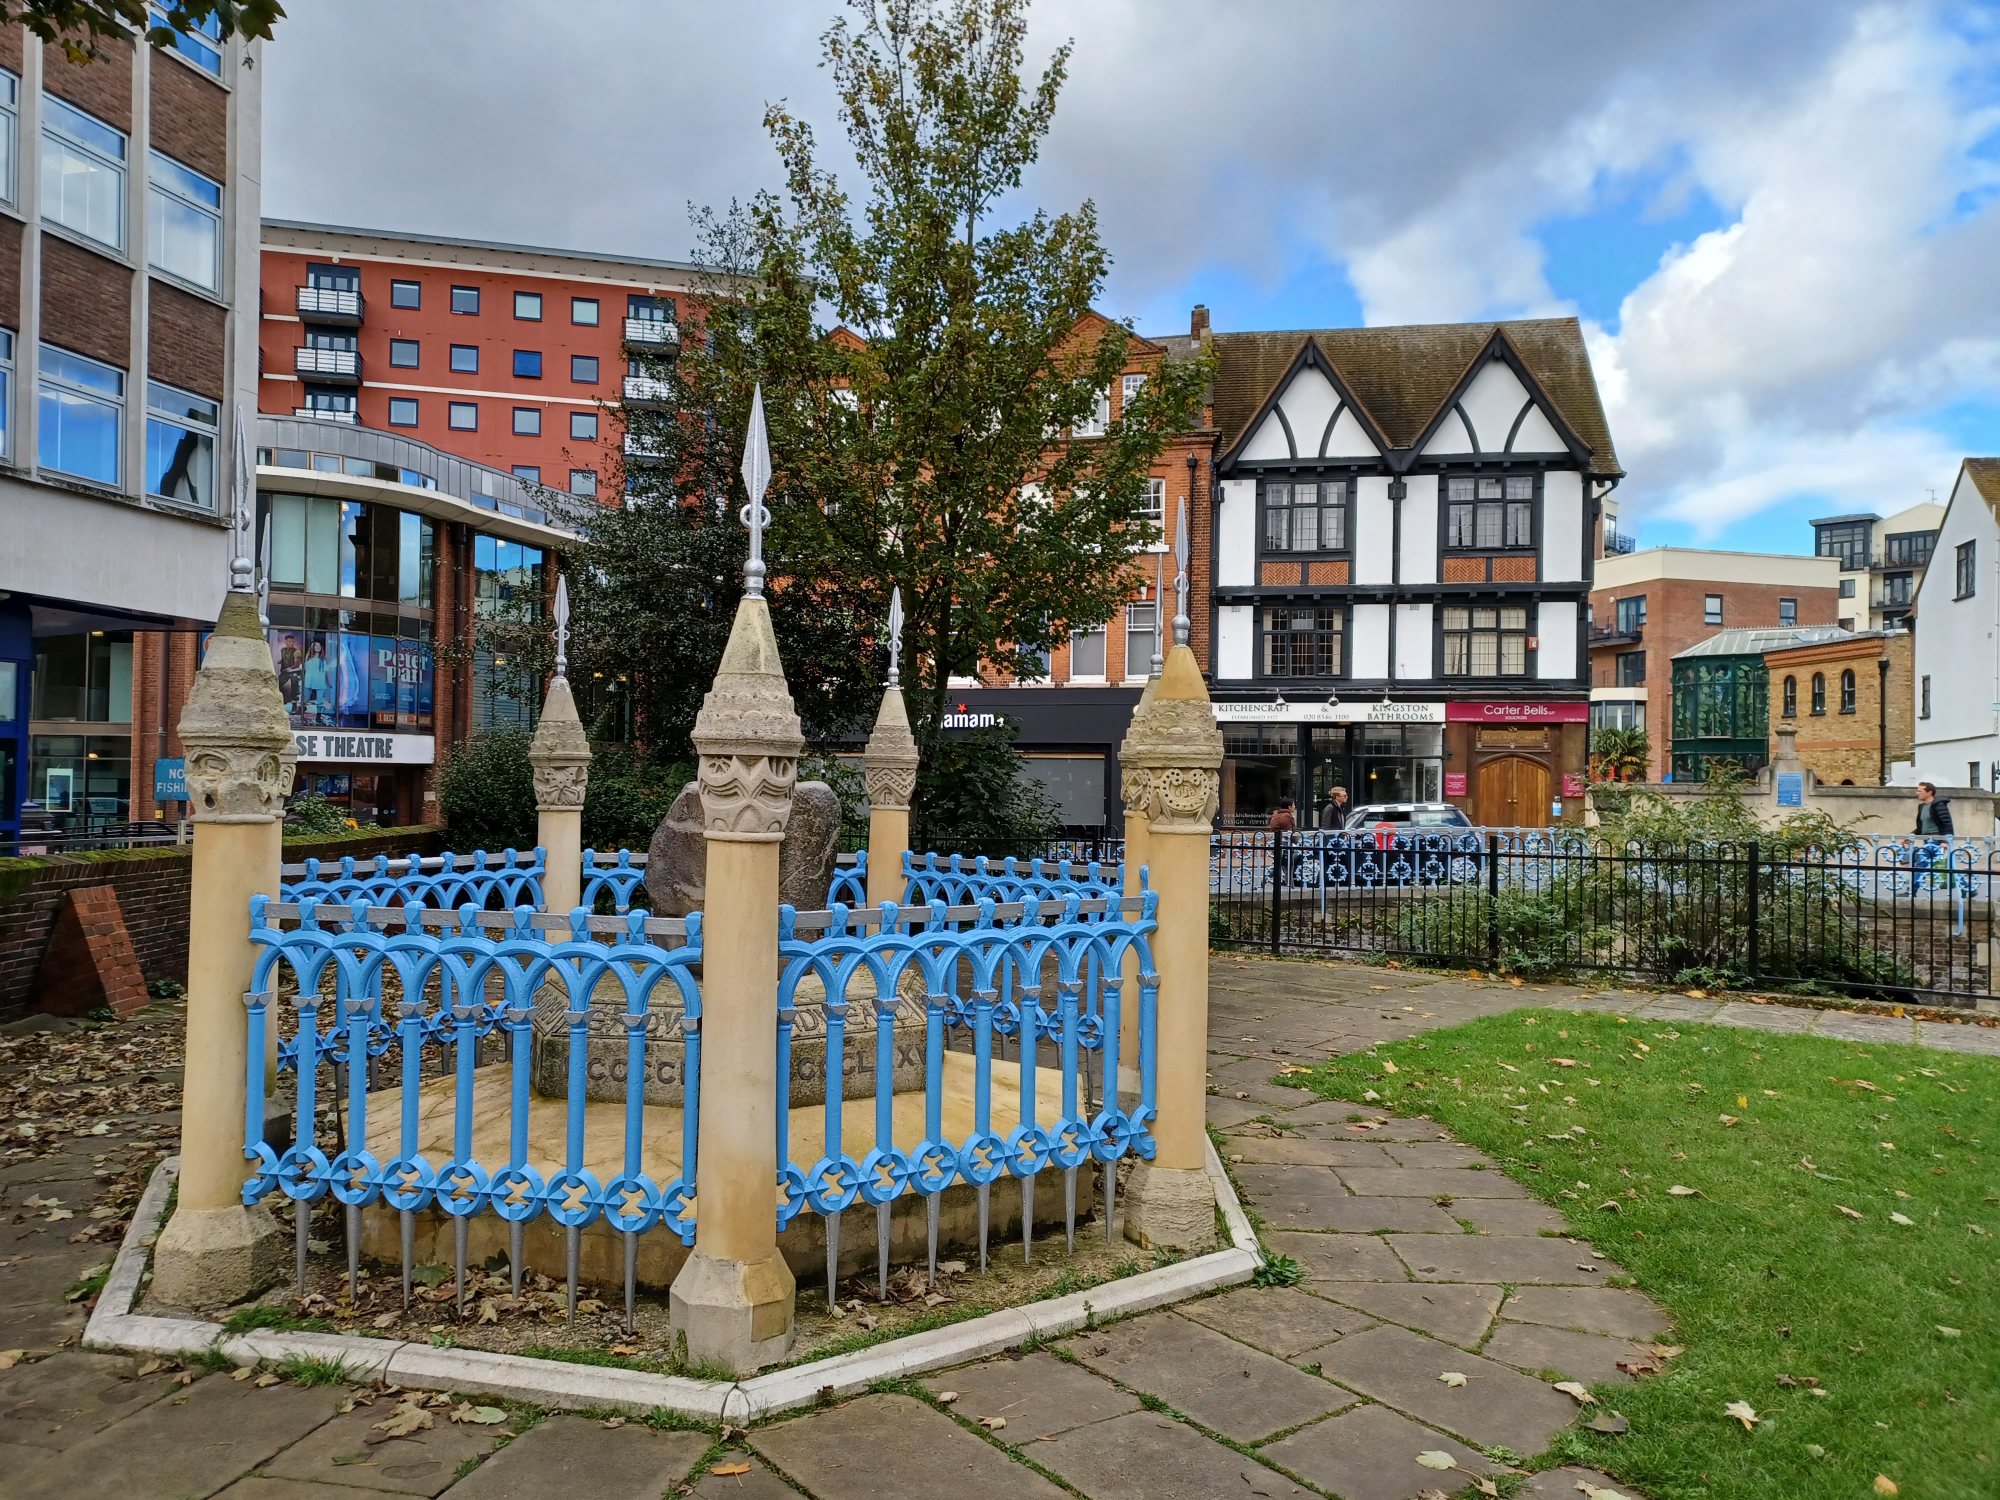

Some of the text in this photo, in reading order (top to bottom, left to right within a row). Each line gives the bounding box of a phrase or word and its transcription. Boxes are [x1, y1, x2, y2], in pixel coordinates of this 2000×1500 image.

[377, 648, 428, 670] Peter
[384, 666, 424, 684] Pan
[1218, 704, 1429, 713] KITCHENCRAFT & KINGSTON
[1484, 704, 1521, 715] Carter
[1524, 704, 1549, 715] Bells
[1367, 713, 1434, 721] BATHROOMS
[296, 735, 393, 758] SE THEATRE
[169, 768, 186, 780] NO
